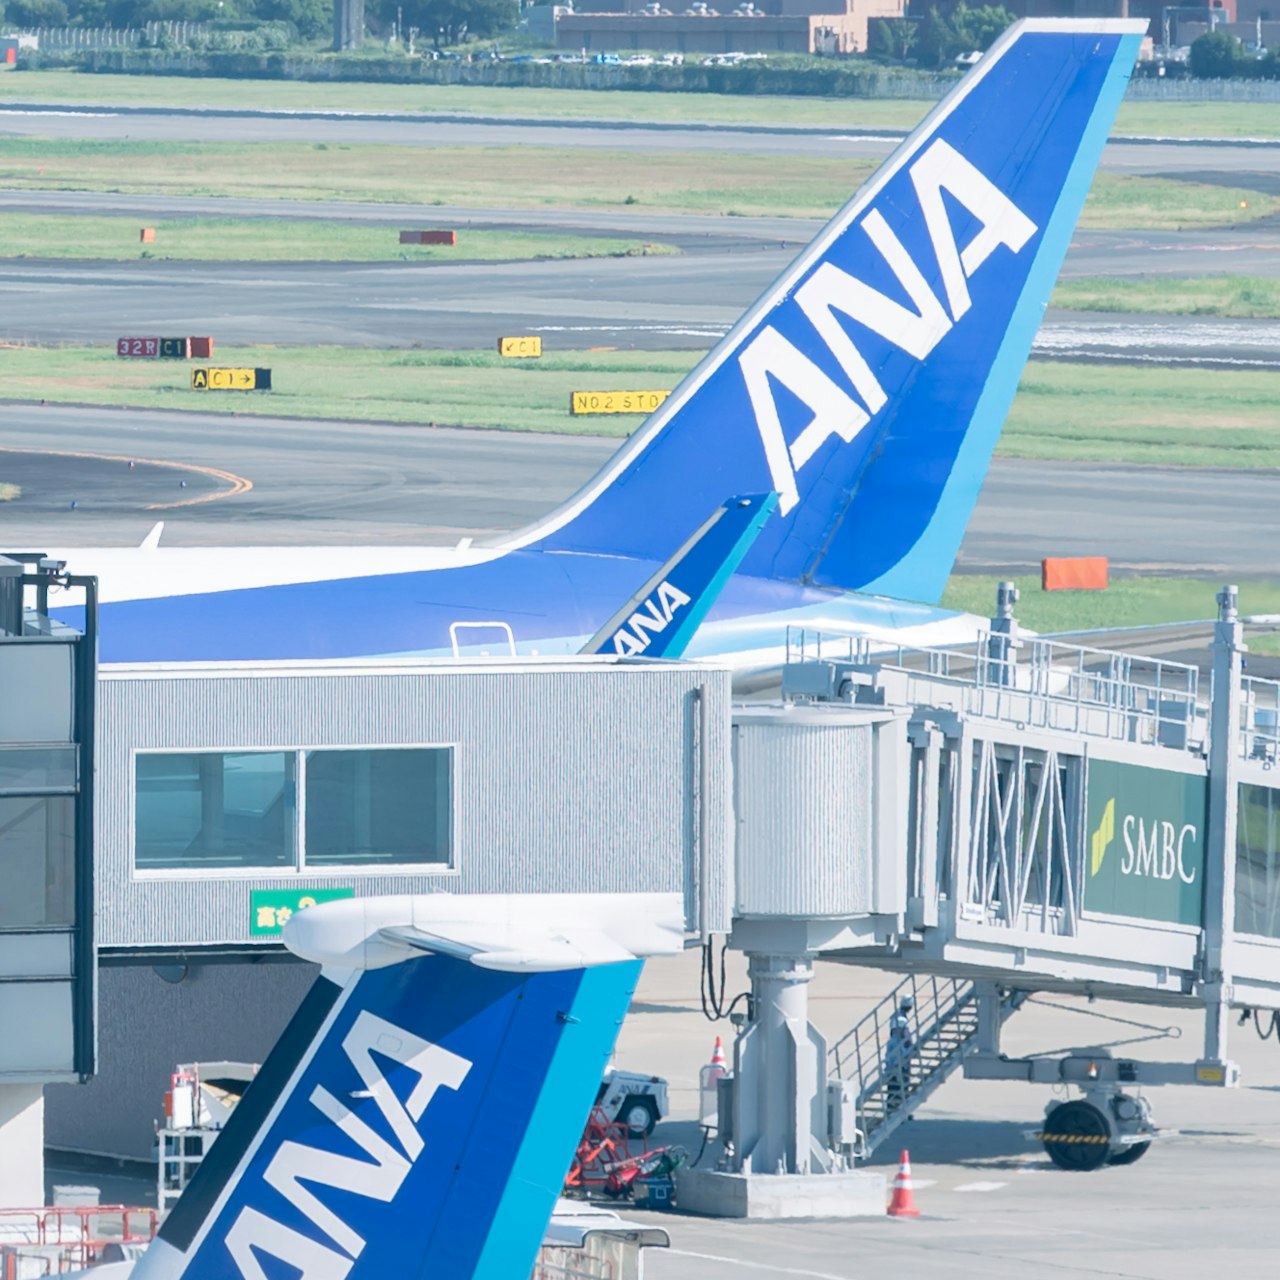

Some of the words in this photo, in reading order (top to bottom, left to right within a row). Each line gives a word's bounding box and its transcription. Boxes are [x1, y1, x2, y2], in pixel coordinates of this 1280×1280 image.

[120, 341, 156, 354] 32R
[164, 341, 182, 354] C1
[738, 137, 1038, 517] ANA
[194, 372, 207, 387] A
[623, 394, 668, 408] STO
[613, 581, 691, 657] ANA
[1121, 814, 1196, 884] SMBC
[224, 1009, 473, 1280] ANA
